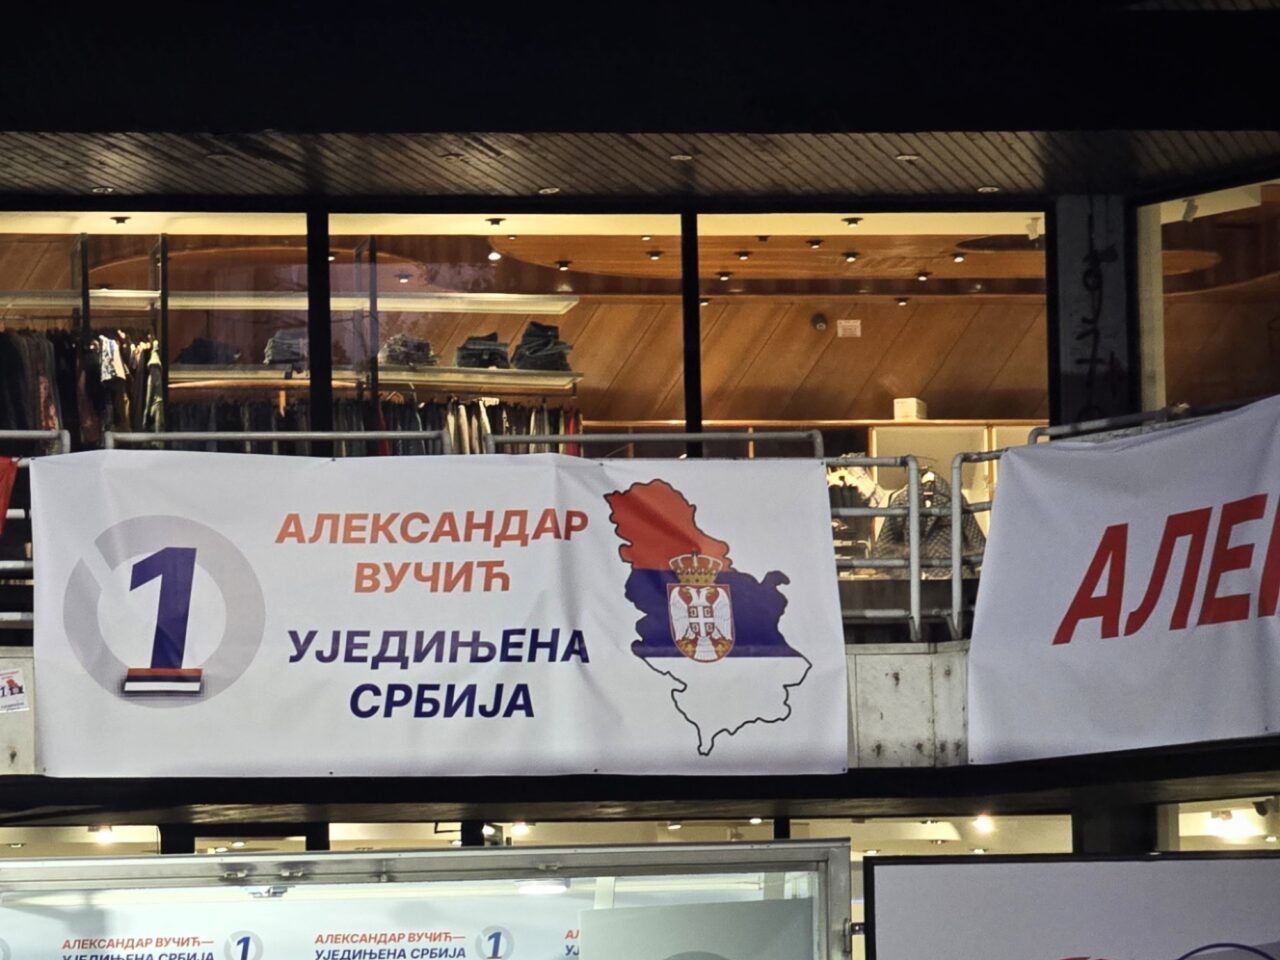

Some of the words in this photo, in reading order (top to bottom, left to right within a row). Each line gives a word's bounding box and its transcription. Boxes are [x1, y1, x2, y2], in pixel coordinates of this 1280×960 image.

[275, 509, 589, 547] АЛЕКСАНДАР
[353, 560, 510, 594] ВУЧИЋ
[124, 545, 203, 692] 1
[287, 627, 591, 671] УЈЕДИЊЕНА
[349, 683, 535, 719] СРБИЈА
[62, 937, 153, 950] АЛЕКСАНДАР
[314, 932, 406, 945] АЛЕКСАНДАР
[410, 947, 466, 959] СРБИЈА
[486, 931, 503, 960] 1
